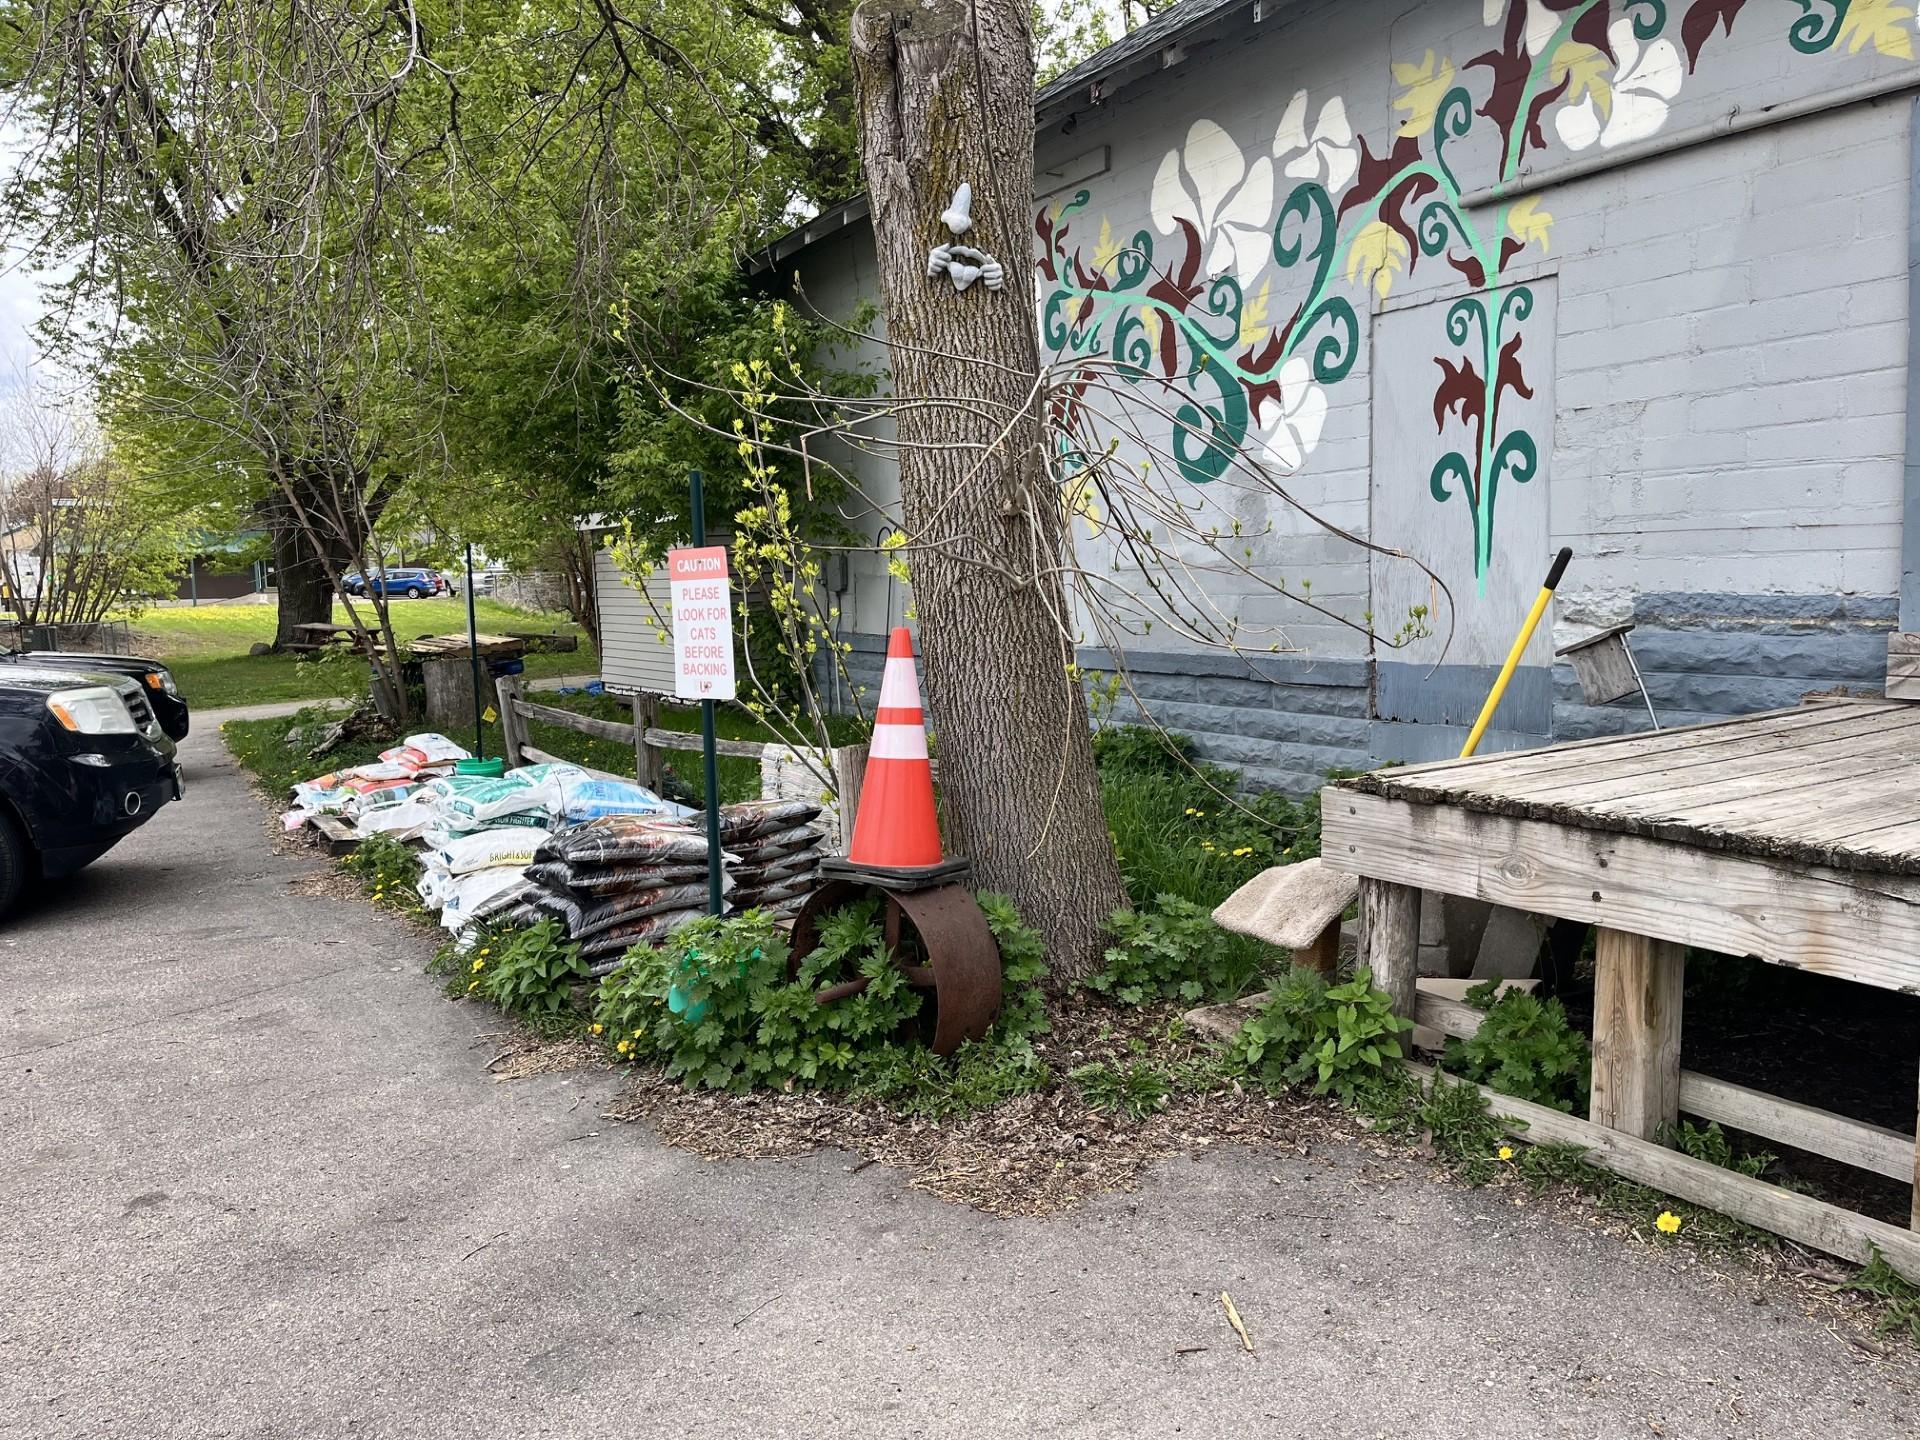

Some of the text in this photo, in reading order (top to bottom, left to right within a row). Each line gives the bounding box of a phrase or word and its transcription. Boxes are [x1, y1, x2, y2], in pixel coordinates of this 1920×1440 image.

[677, 557, 721, 573] CAUTION
[682, 586, 720, 601] PLEASE
[677, 607, 727, 621] LOOK FOR
[690, 627, 716, 641] CATS
[685, 646, 724, 659] BEFORE
[683, 663, 727, 676] BACKING
[699, 681, 713, 693] UP
